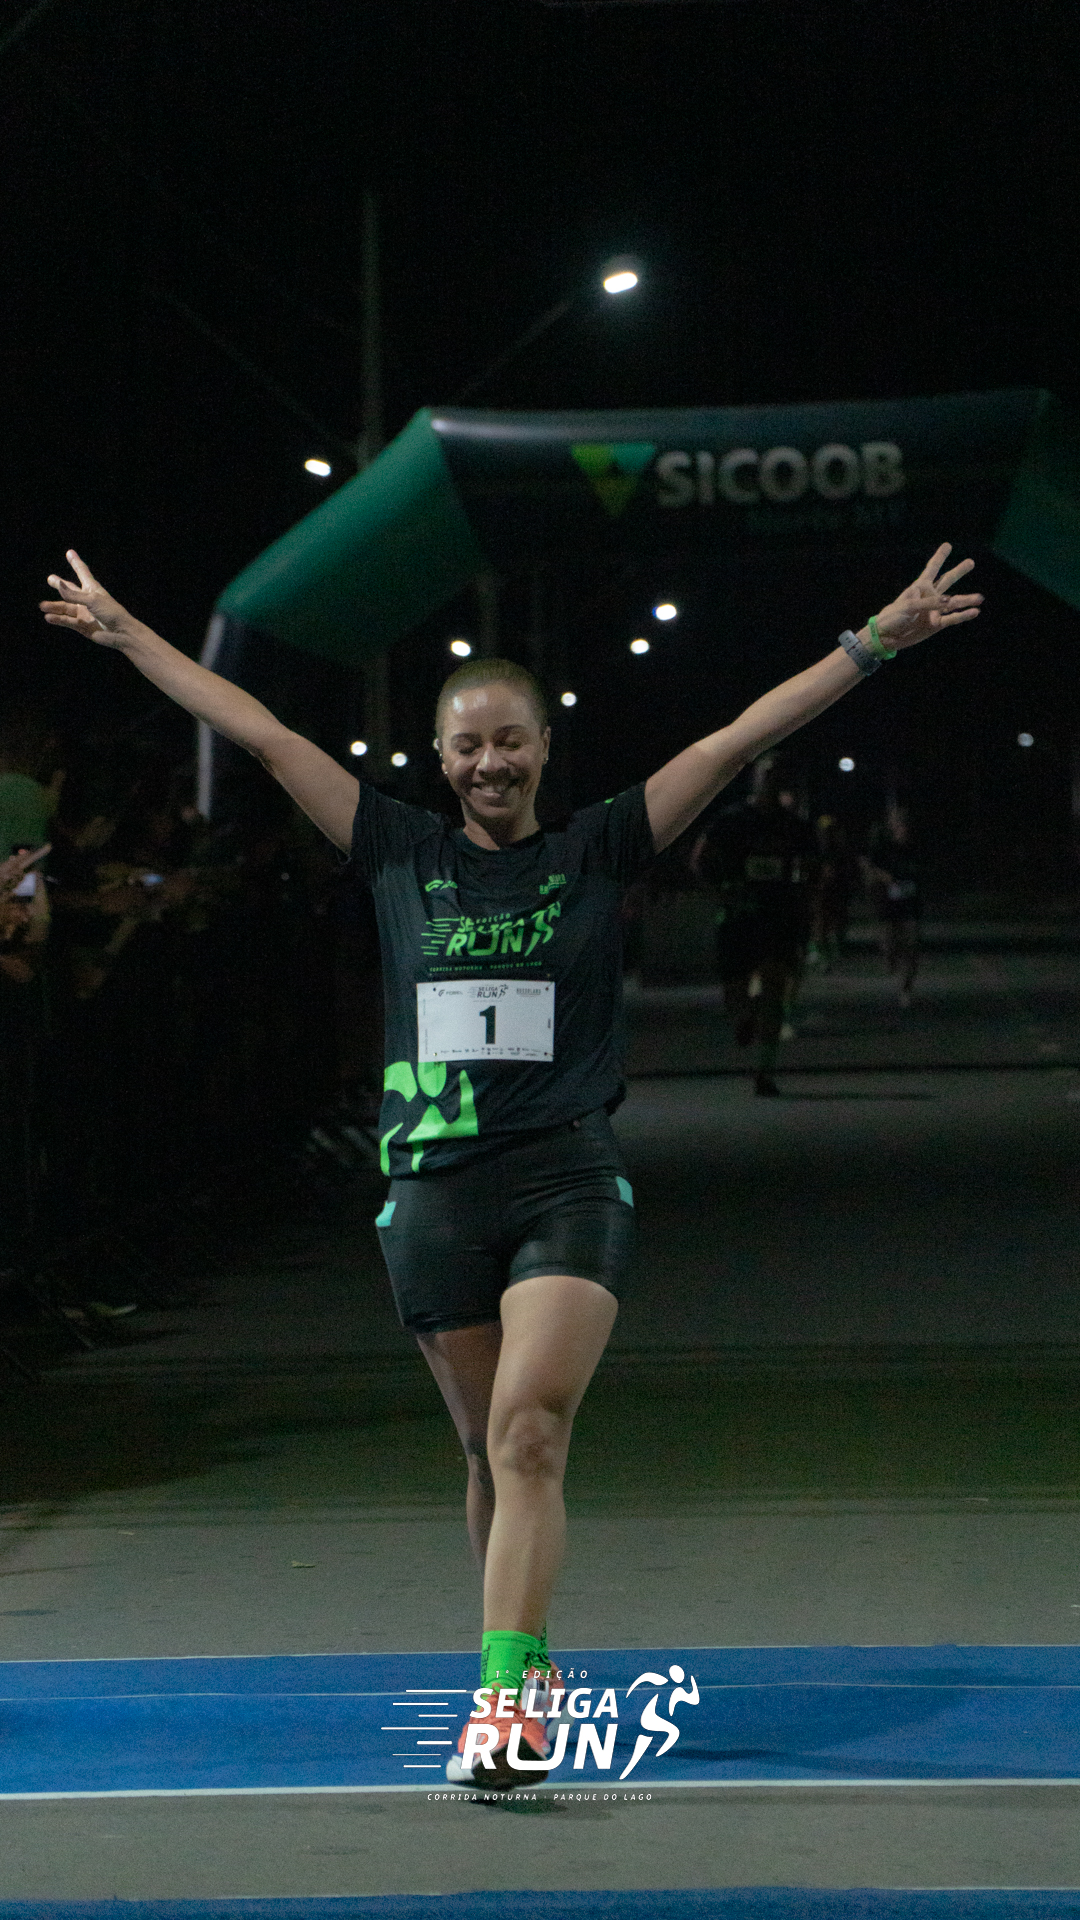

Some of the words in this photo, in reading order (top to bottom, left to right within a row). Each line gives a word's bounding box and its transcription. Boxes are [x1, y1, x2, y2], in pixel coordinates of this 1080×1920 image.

[655, 440, 906, 508] SICOOB
[446, 927, 525, 957] RUN
[477, 991, 498, 999] RUN
[479, 1005, 497, 1045] 1
